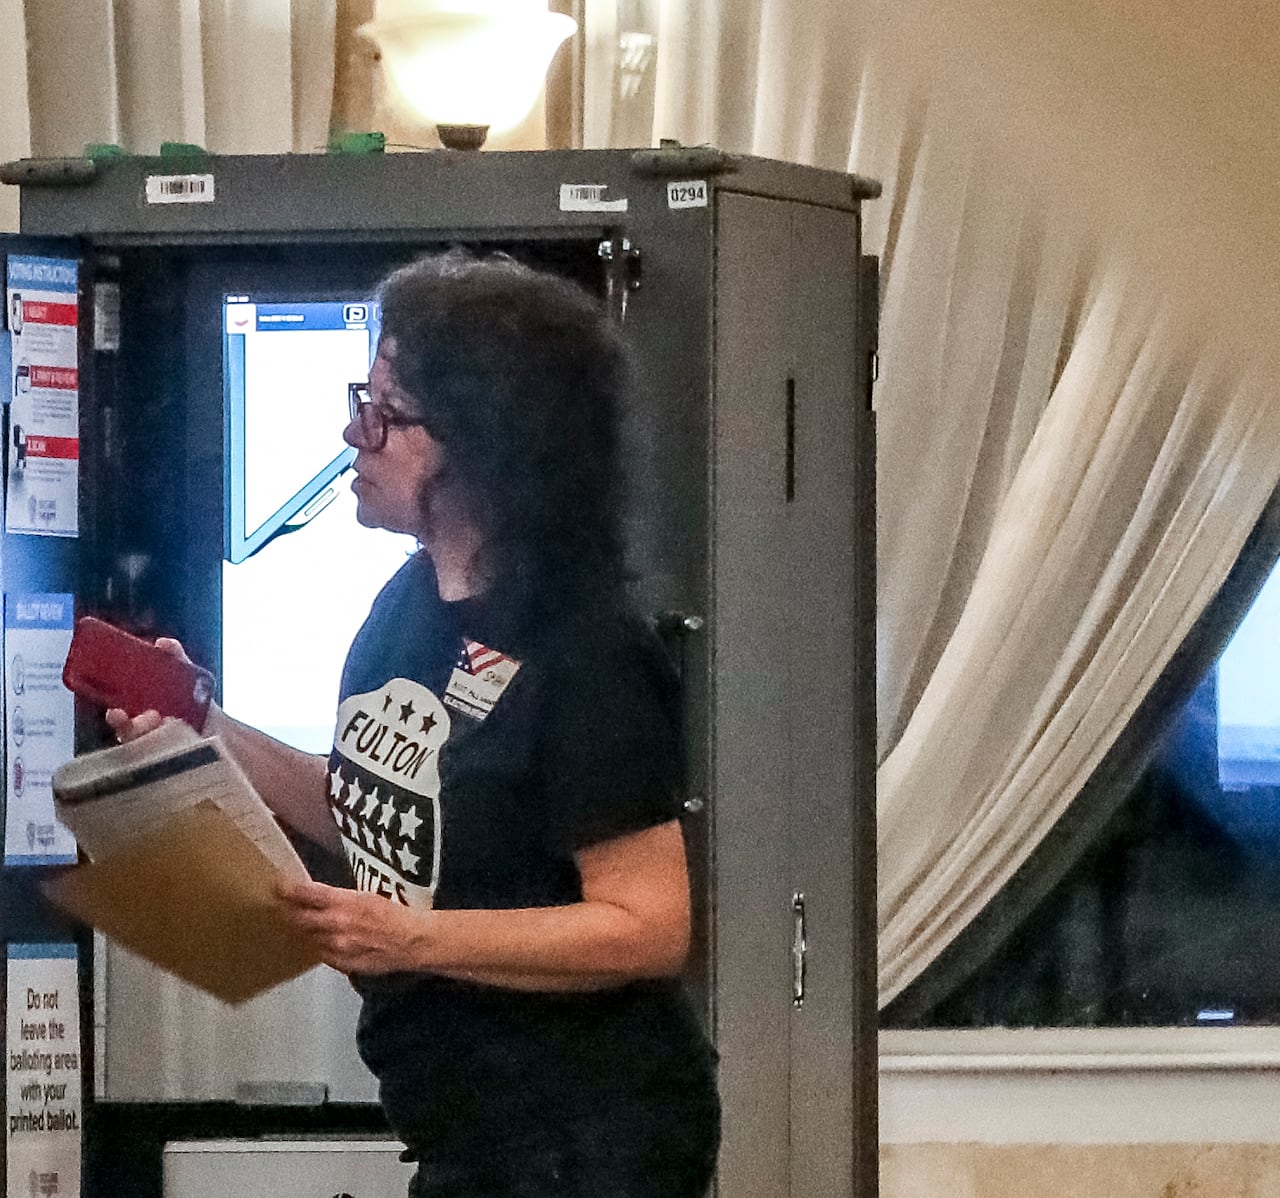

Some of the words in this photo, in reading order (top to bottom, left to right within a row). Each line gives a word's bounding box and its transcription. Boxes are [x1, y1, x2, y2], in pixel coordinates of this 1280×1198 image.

[671, 187, 704, 201] 0294
[341, 709, 434, 780] FULTON
[26, 988, 40, 1010] Do
[42, 989, 59, 1010] not
[20, 1018, 46, 1041] leave
[48, 1018, 65, 1040] the
[10, 1050, 52, 1076] balloting
[54, 1053, 78, 1070] area
[20, 1081, 42, 1101] with
[43, 1084, 67, 1106] your
[10, 1111, 44, 1136] printed
[46, 1110, 80, 1132] ballot.
